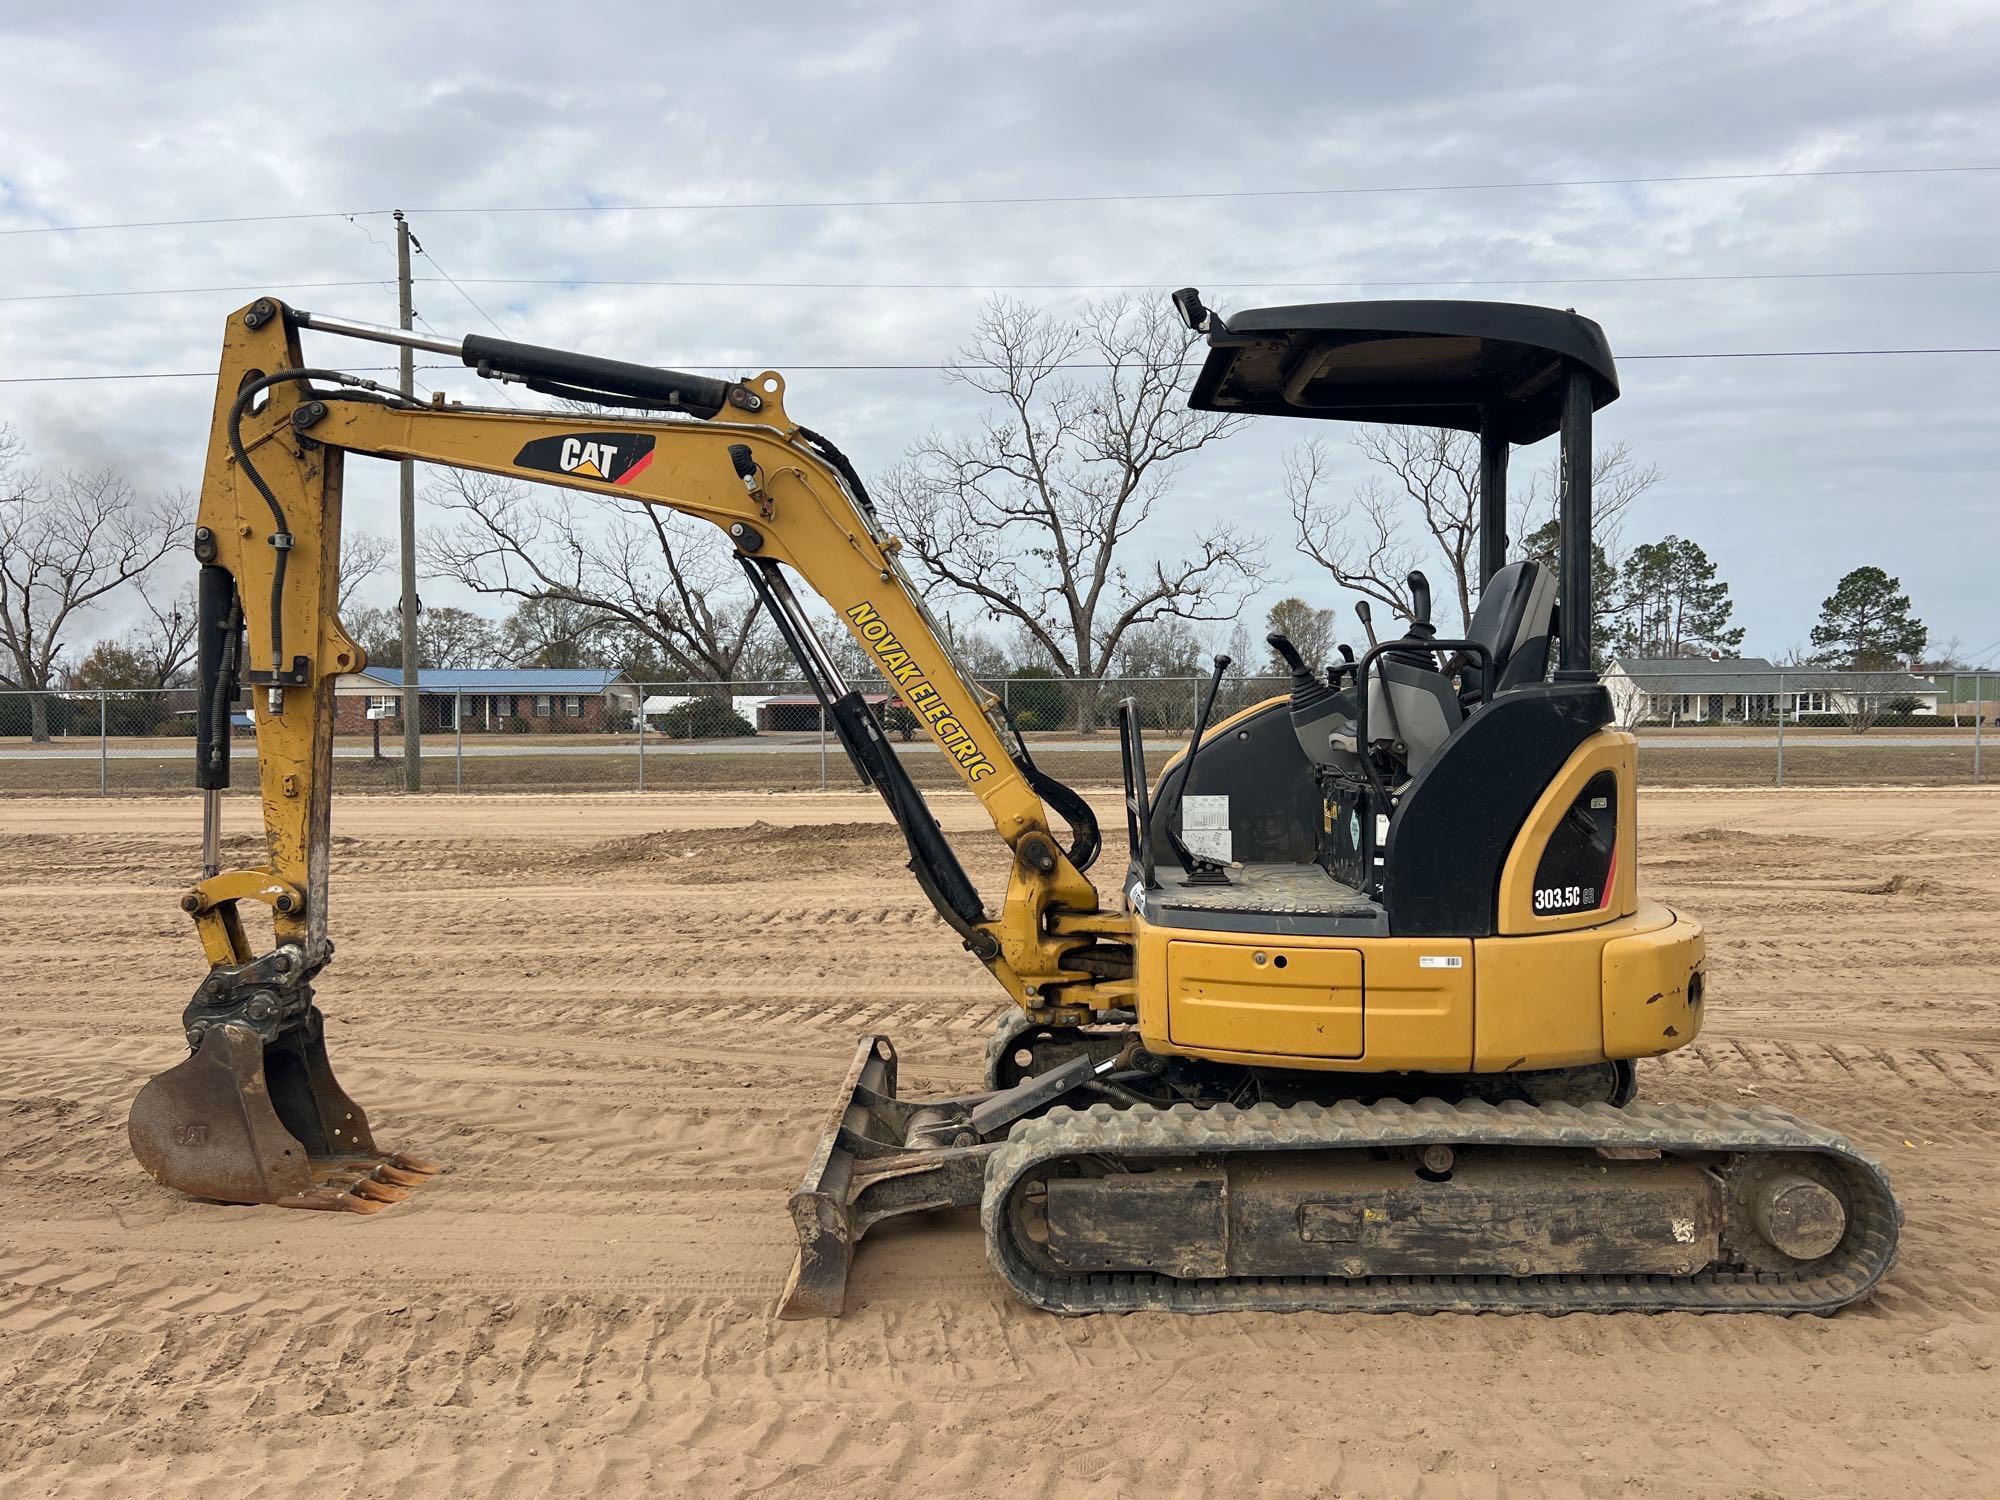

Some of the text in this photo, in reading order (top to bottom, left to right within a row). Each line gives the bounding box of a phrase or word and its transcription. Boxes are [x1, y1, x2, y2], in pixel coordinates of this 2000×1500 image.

[559, 437, 618, 479] CAT
[845, 601, 997, 782] NOVAK ELECTRIC
[1534, 886, 1580, 909] 303.5C
